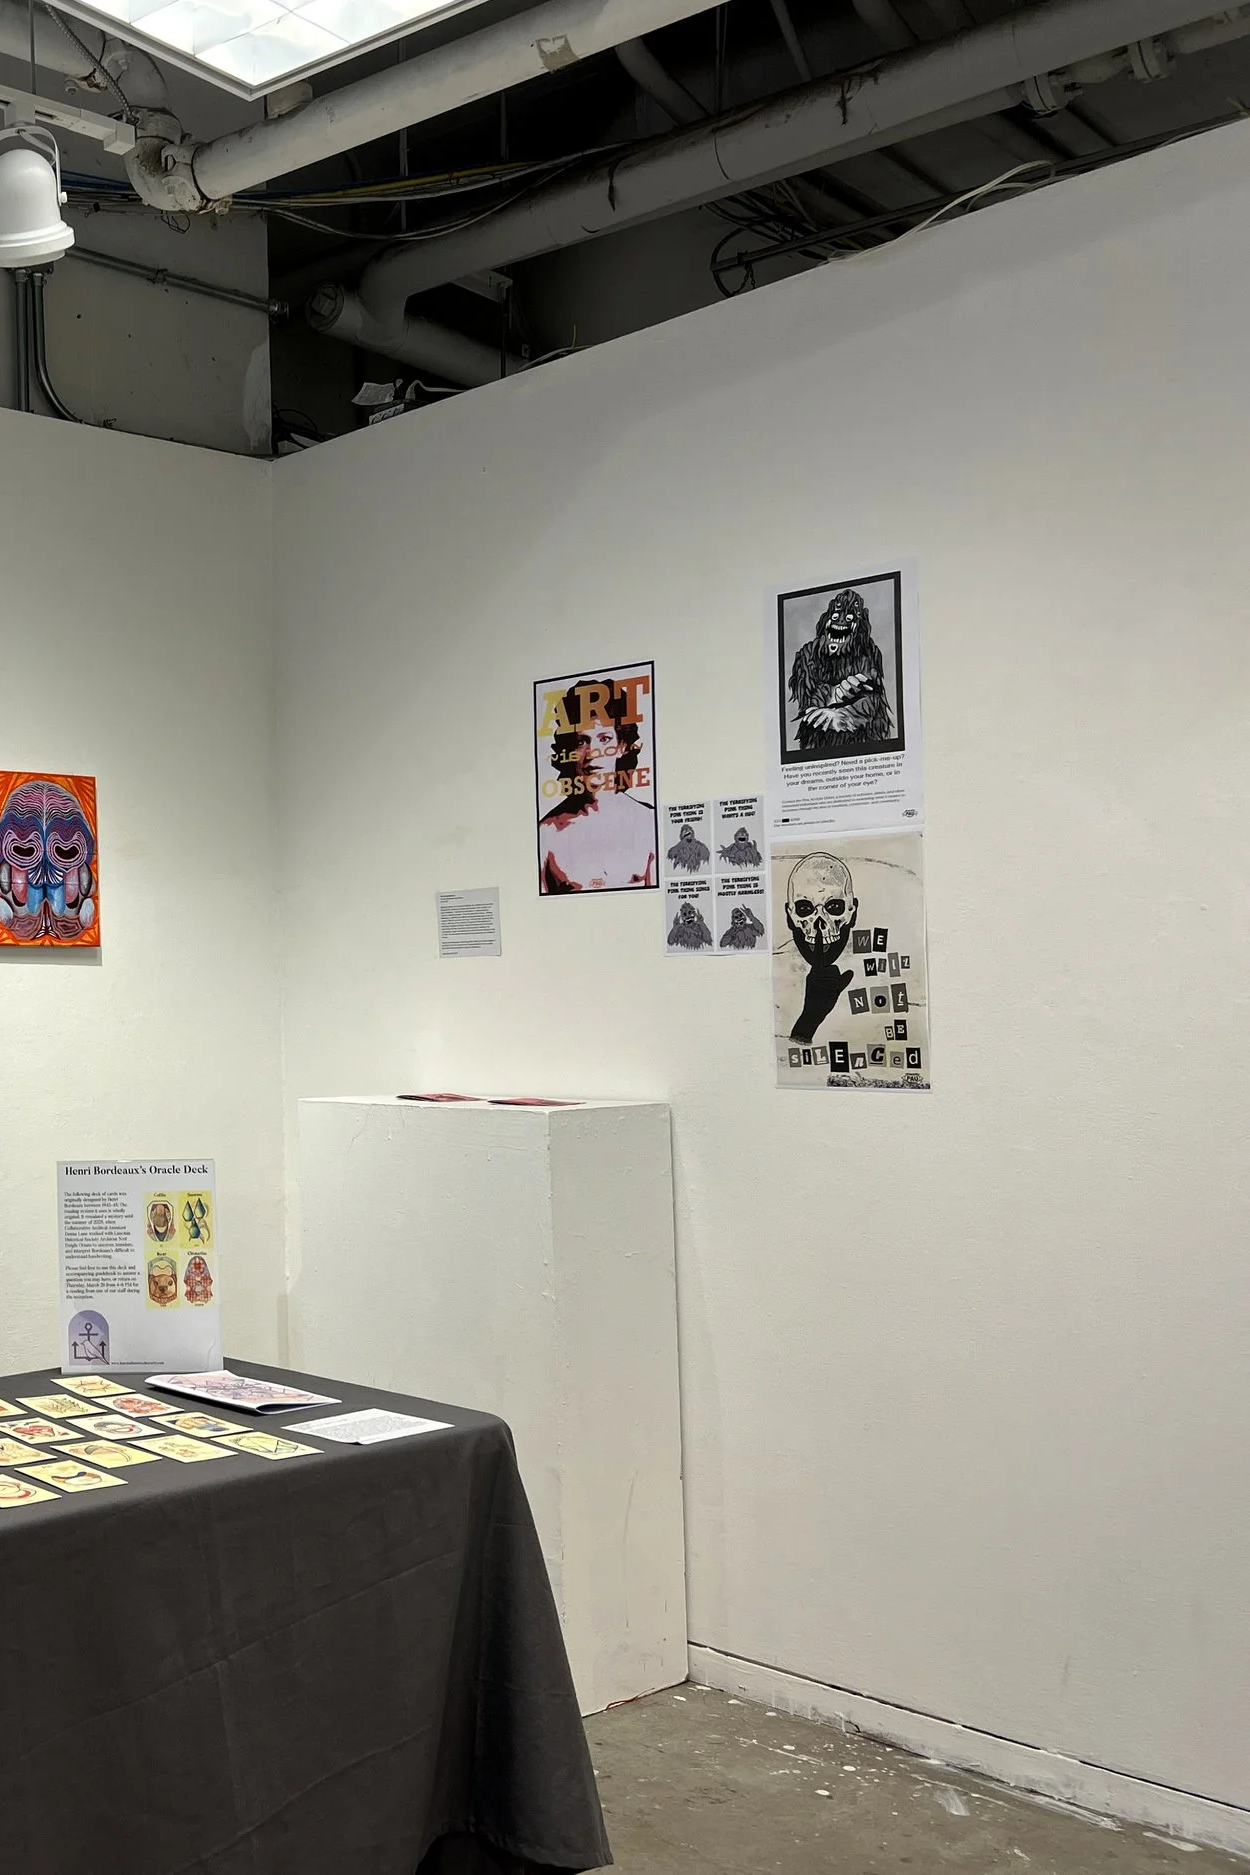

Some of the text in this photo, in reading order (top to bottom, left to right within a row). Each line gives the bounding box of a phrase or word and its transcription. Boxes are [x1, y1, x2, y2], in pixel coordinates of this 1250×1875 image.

[538, 675, 650, 737] ART
[781, 765, 803, 773] Feeling
[805, 761, 840, 770] uninspired?
[864, 754, 905, 764] pick-me-up?
[813, 769, 837, 777] recently
[541, 768, 650, 798] OBSCENE
[65, 1165, 208, 1175] Henri Bordeaux's Oracle Deck
